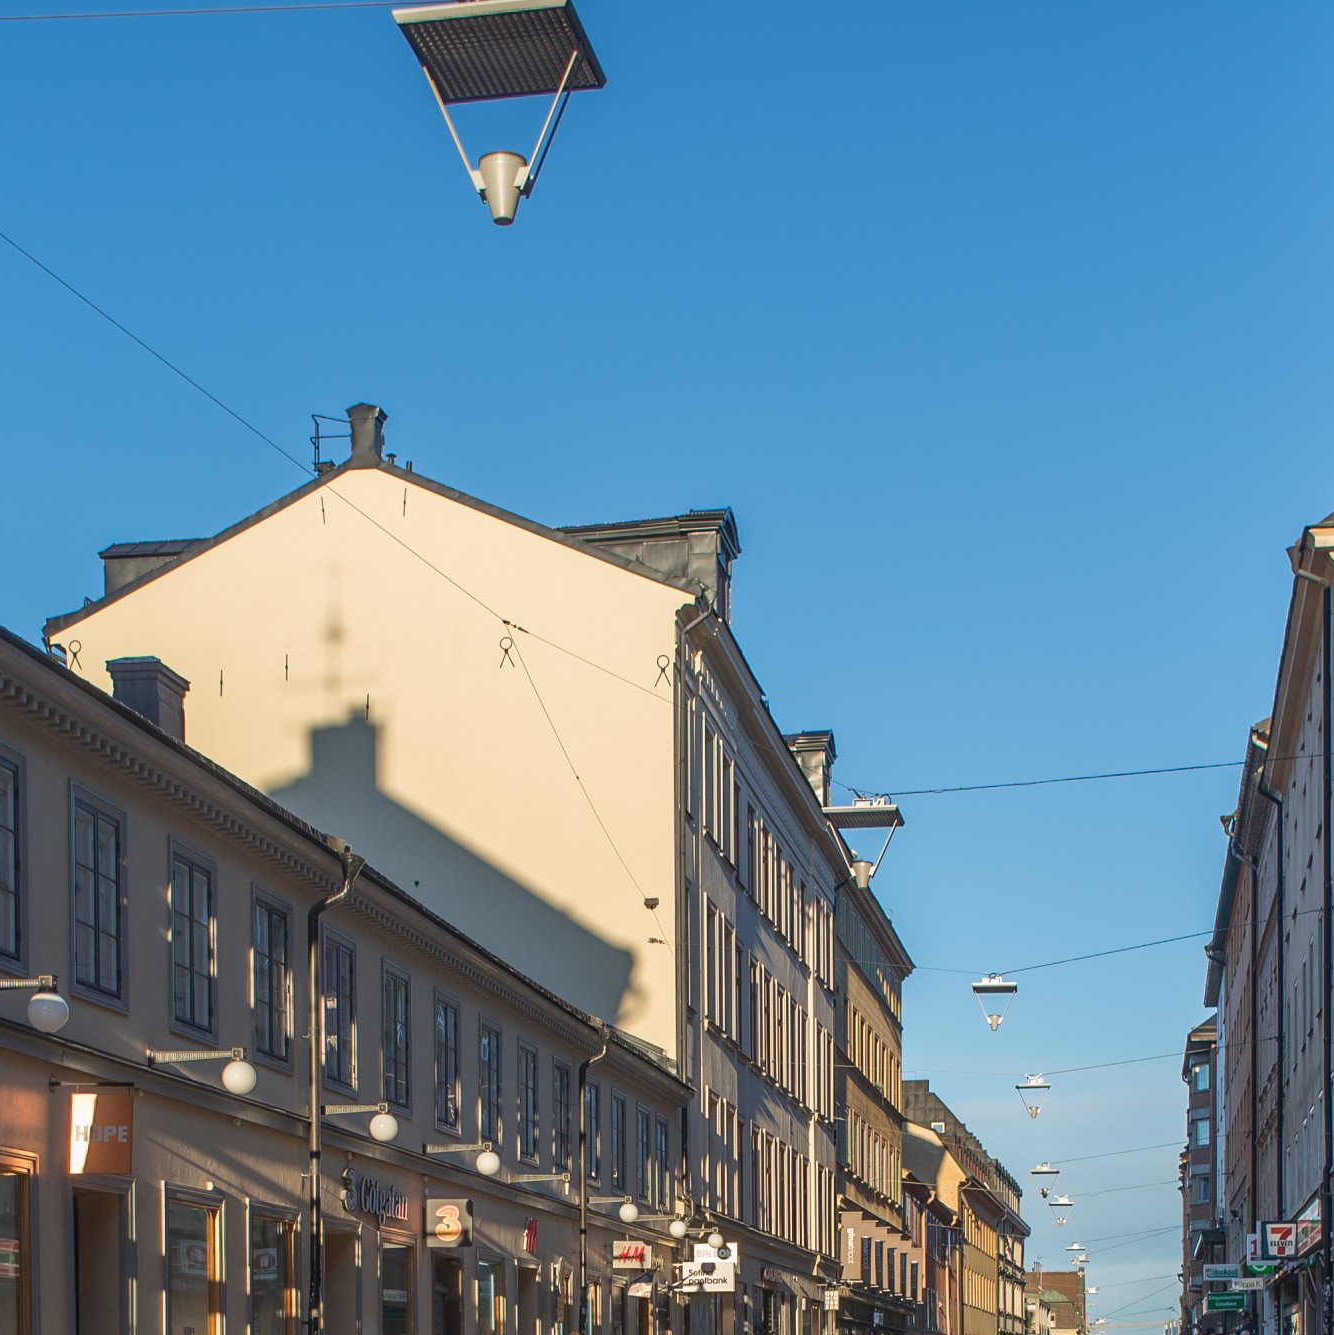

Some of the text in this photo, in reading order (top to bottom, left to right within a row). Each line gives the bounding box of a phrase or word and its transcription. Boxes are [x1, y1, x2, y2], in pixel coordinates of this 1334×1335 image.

[75, 1125, 128, 1142] HOPE
[360, 1175, 409, 1226] Götgatan
[435, 1204, 462, 1242] 3
[1270, 1227, 1292, 1255] 7
[688, 1269, 715, 1277] Sefina
[688, 1276, 728, 1285] pantbank
